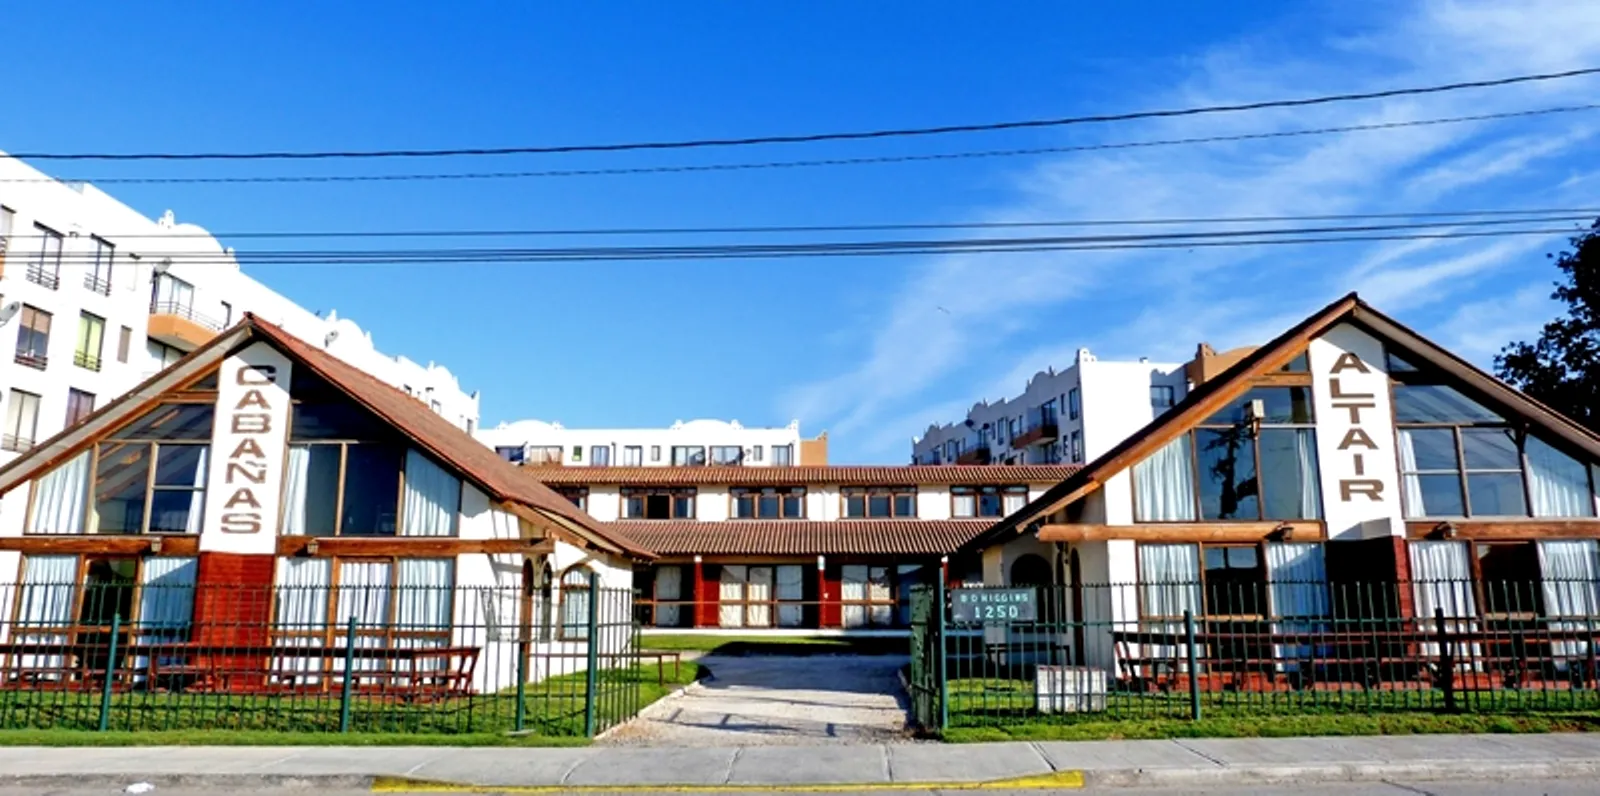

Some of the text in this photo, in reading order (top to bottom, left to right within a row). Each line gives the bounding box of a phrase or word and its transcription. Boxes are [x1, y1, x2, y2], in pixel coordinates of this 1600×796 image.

[220, 364, 277, 534] CABAÑAS
[1329, 352, 1384, 502] ALTAIR
[974, 605, 1019, 619] 1250
